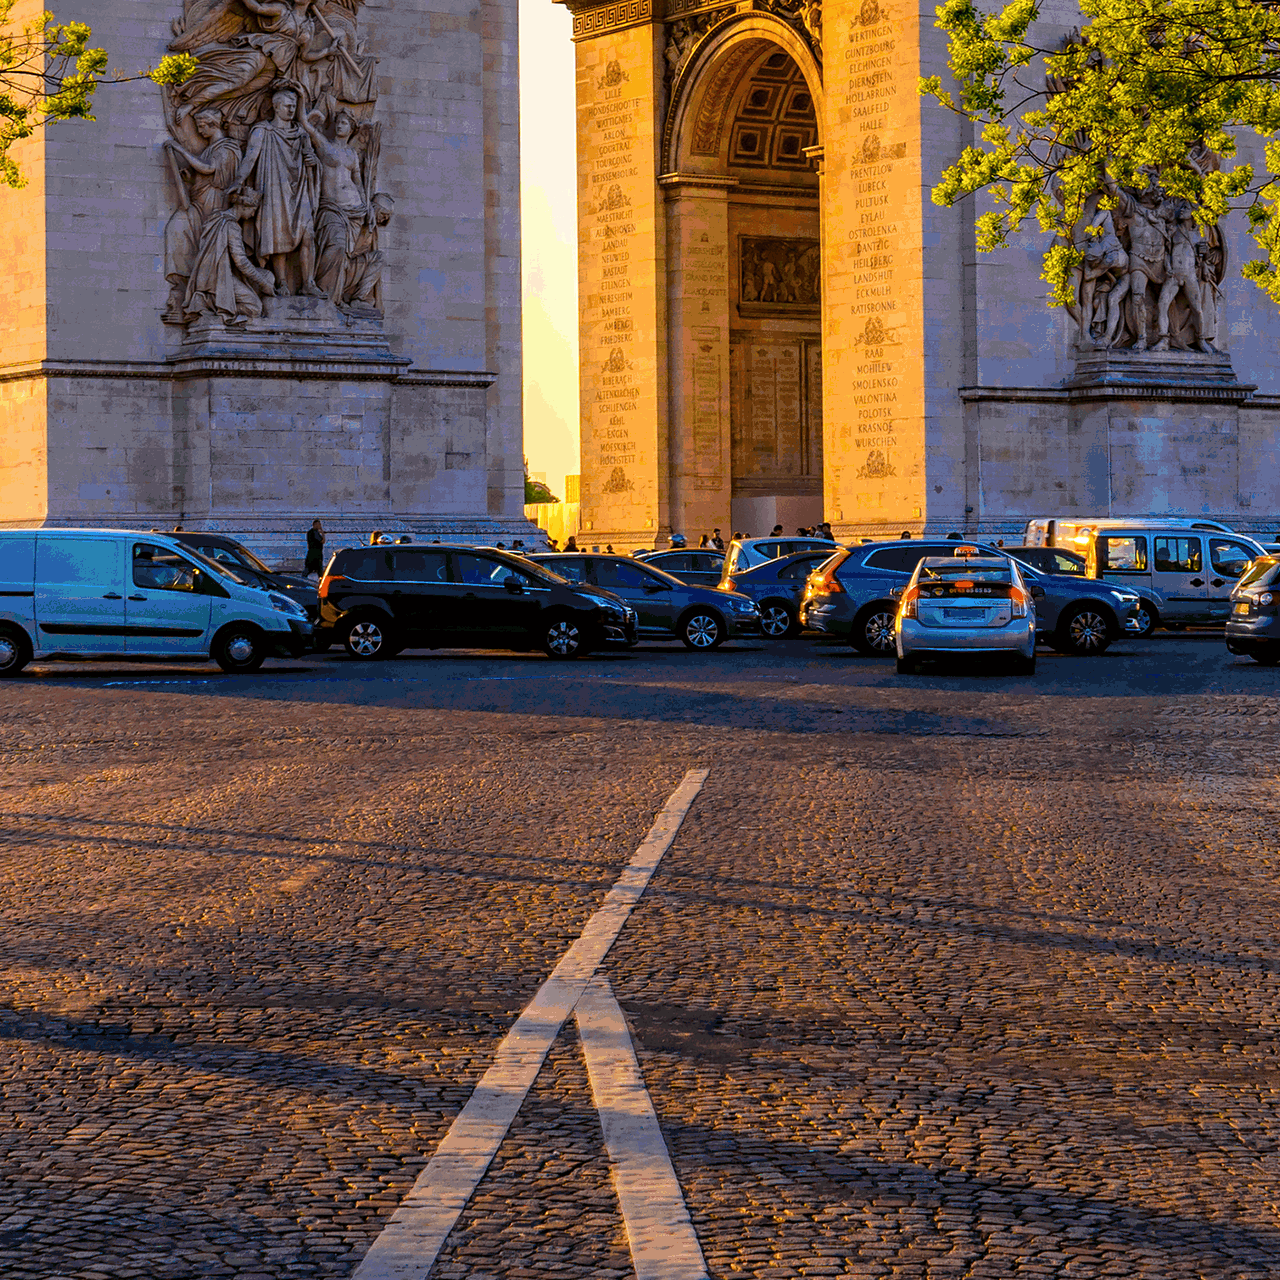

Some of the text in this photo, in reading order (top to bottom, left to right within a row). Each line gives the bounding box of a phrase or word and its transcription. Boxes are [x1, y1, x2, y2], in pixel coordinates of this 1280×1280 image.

[849, 25, 893, 43] WERTINGEN
[845, 40, 896, 60] GUNTZBOURG
[849, 56, 892, 74] ELCHINGEN
[849, 72, 893, 90] DIERNSTEIN
[605, 88, 622, 99] LILLE
[846, 85, 897, 105] HOLLABRUNN
[853, 101, 890, 118] SAALFELD
[859, 118, 882, 132] HALLE
[850, 164, 893, 180] PRENTZLOW
[858, 180, 886, 194] LUBECK
[855, 194, 890, 209] PULTUSK
[860, 210, 885, 224] EYLAU
[848, 224, 898, 240] OSTROLENKA
[856, 239, 890, 255] DANTZIG
[853, 254, 894, 269] HEILSBERG
[853, 269, 894, 285] LANDSHUT
[856, 285, 892, 299] ECKMULH
[850, 300, 897, 315] RATISBONNE
[864, 347, 884, 359] RAAB
[856, 362, 893, 375] MOHILEW
[852, 376, 898, 391] SMOLENSKO
[853, 392, 898, 405] VALONTINA
[858, 407, 893, 419] POLOTSK
[854, 436, 898, 448] WURSCHEN
